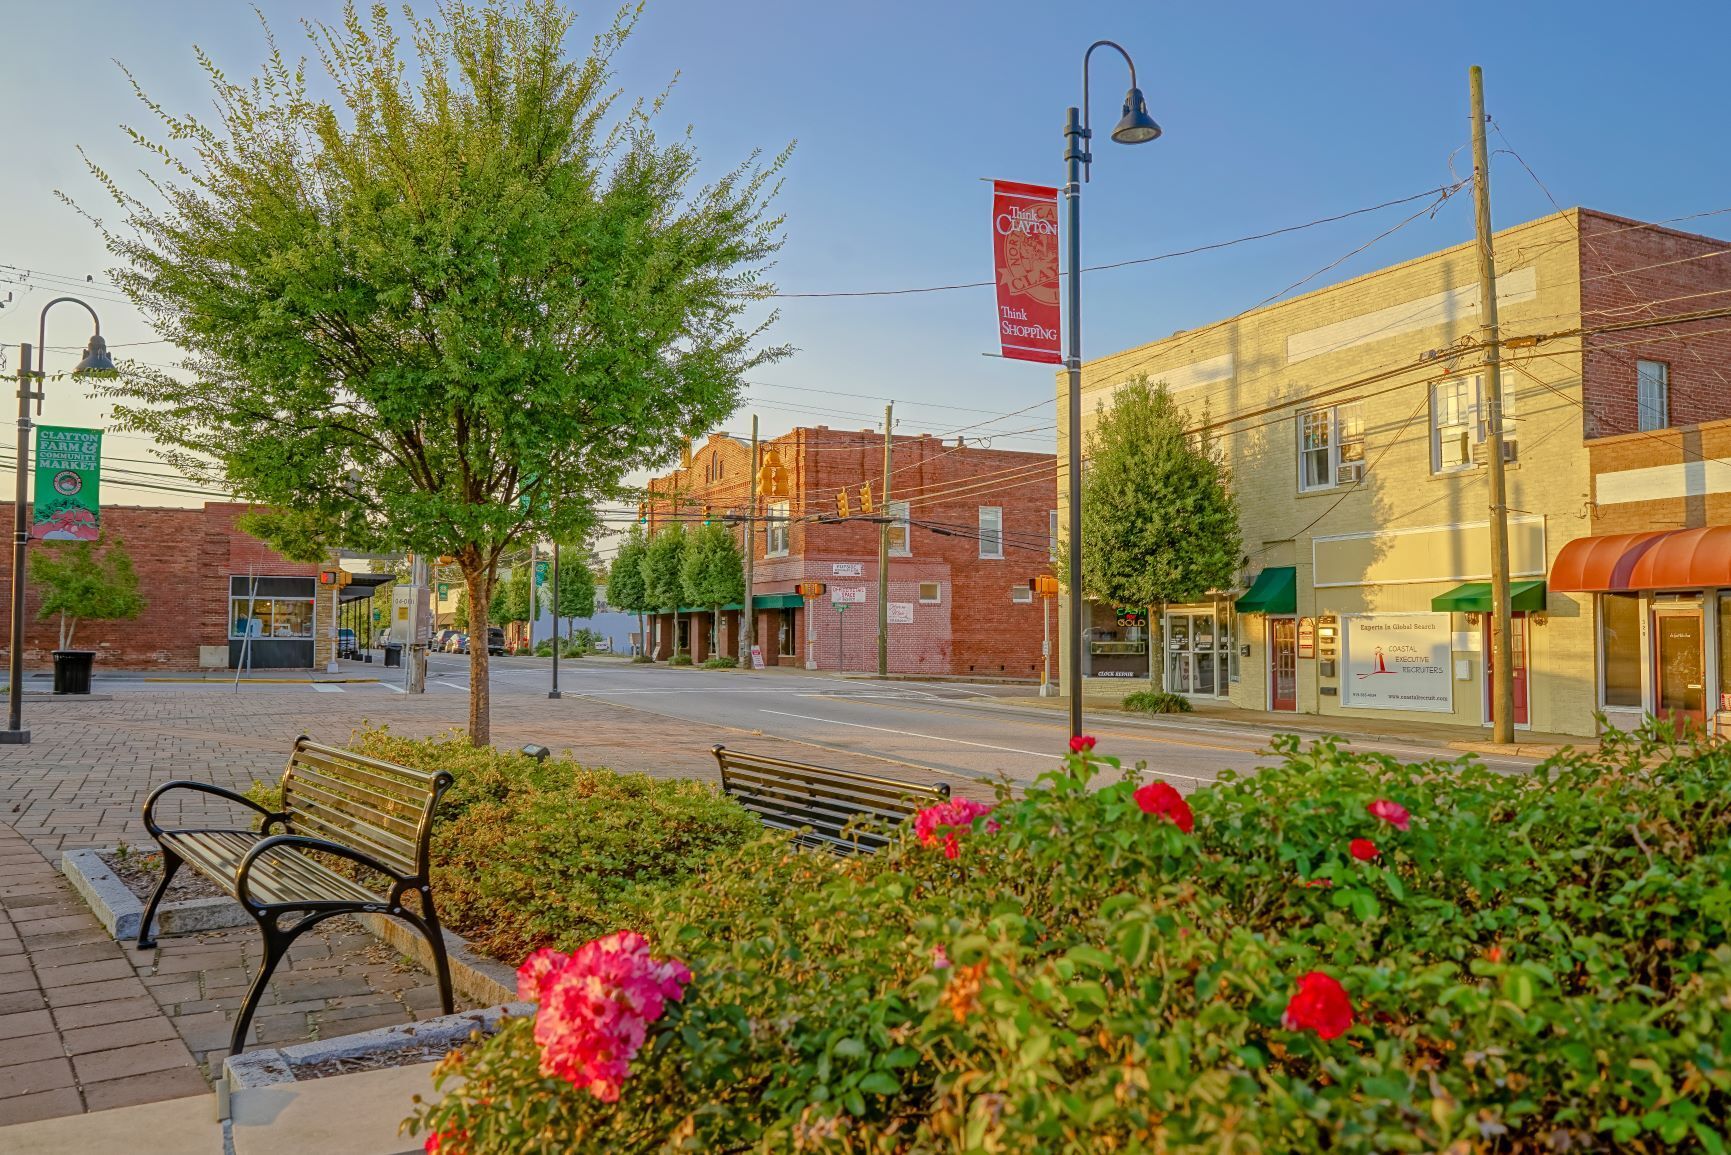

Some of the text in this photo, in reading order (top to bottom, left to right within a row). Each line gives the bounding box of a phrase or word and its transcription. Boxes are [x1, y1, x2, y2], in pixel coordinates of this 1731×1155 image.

[1009, 206, 1038, 222] Think
[996, 214, 1058, 237] CLAYTON
[1001, 305, 1028, 321] Think
[1001, 320, 1058, 341] SHOPPING
[40, 431, 98, 441] CLAYTON
[40, 441, 98, 453] FARM &
[40, 452, 97, 460] COMMUNITY
[40, 460, 97, 470] MARKET
[1117, 619, 1146, 627] GOLD
[1388, 645, 1418, 653] COASTAL
[1395, 656, 1430, 664] EXECUTIVE
[1402, 666, 1444, 674] RECRUITERS
